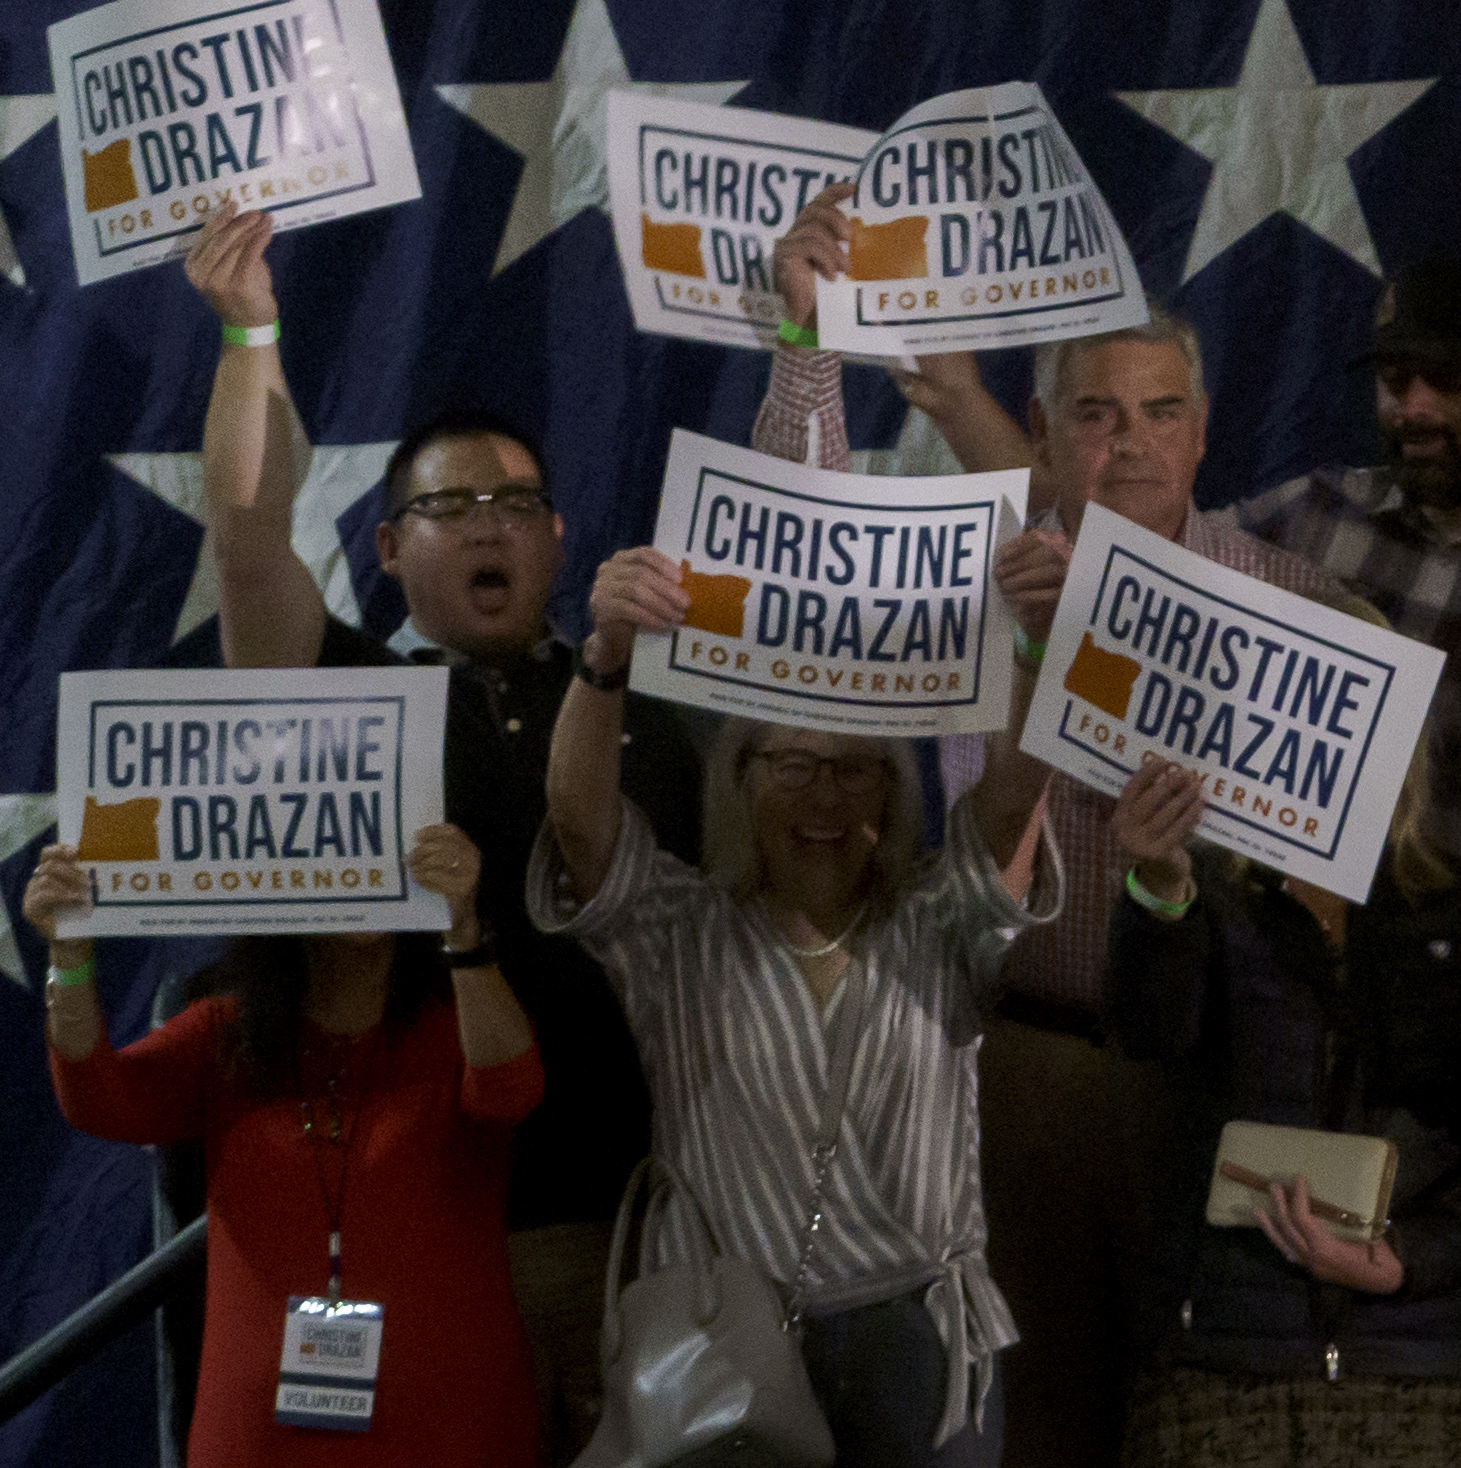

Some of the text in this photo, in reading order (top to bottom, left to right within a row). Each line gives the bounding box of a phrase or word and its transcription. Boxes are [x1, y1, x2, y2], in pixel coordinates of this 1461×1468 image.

[106, 209, 154, 238] FOR
[939, 189, 1106, 277] DRAZAN
[877, 266, 1112, 311] FOR GOVERNOR
[705, 494, 978, 589] CHRISTINE
[757, 583, 970, 662] DRAZAN
[1107, 574, 1370, 740] CHRISTINE
[690, 641, 961, 694] FOR GOVERNOR
[106, 716, 385, 788] CHRISTINE
[1078, 714, 1127, 755] FOR
[1135, 670, 1345, 809] DRAZAN
[172, 791, 383, 861] DRAZAN
[112, 868, 385, 893] FOR GOVERNOR
